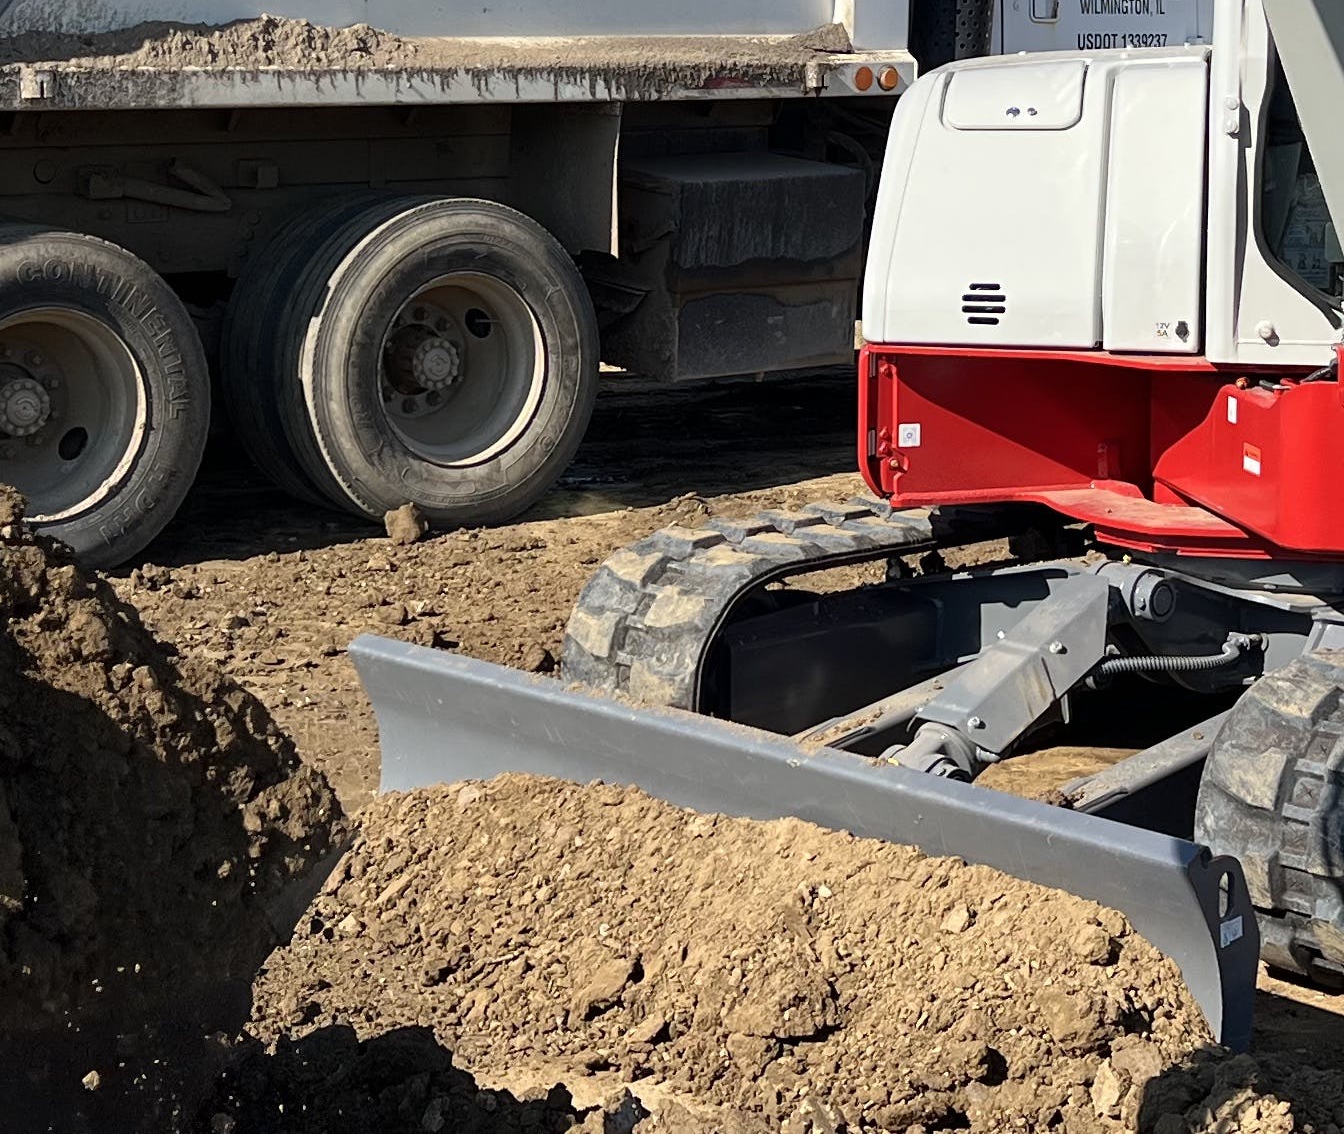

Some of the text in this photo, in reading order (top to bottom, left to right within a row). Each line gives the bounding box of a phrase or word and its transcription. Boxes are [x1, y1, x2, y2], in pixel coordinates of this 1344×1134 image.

[1156, 0, 1166, 15] IL
[1078, 34, 1118, 50] USDOT
[17, 259, 191, 419] CONTINENTAL
